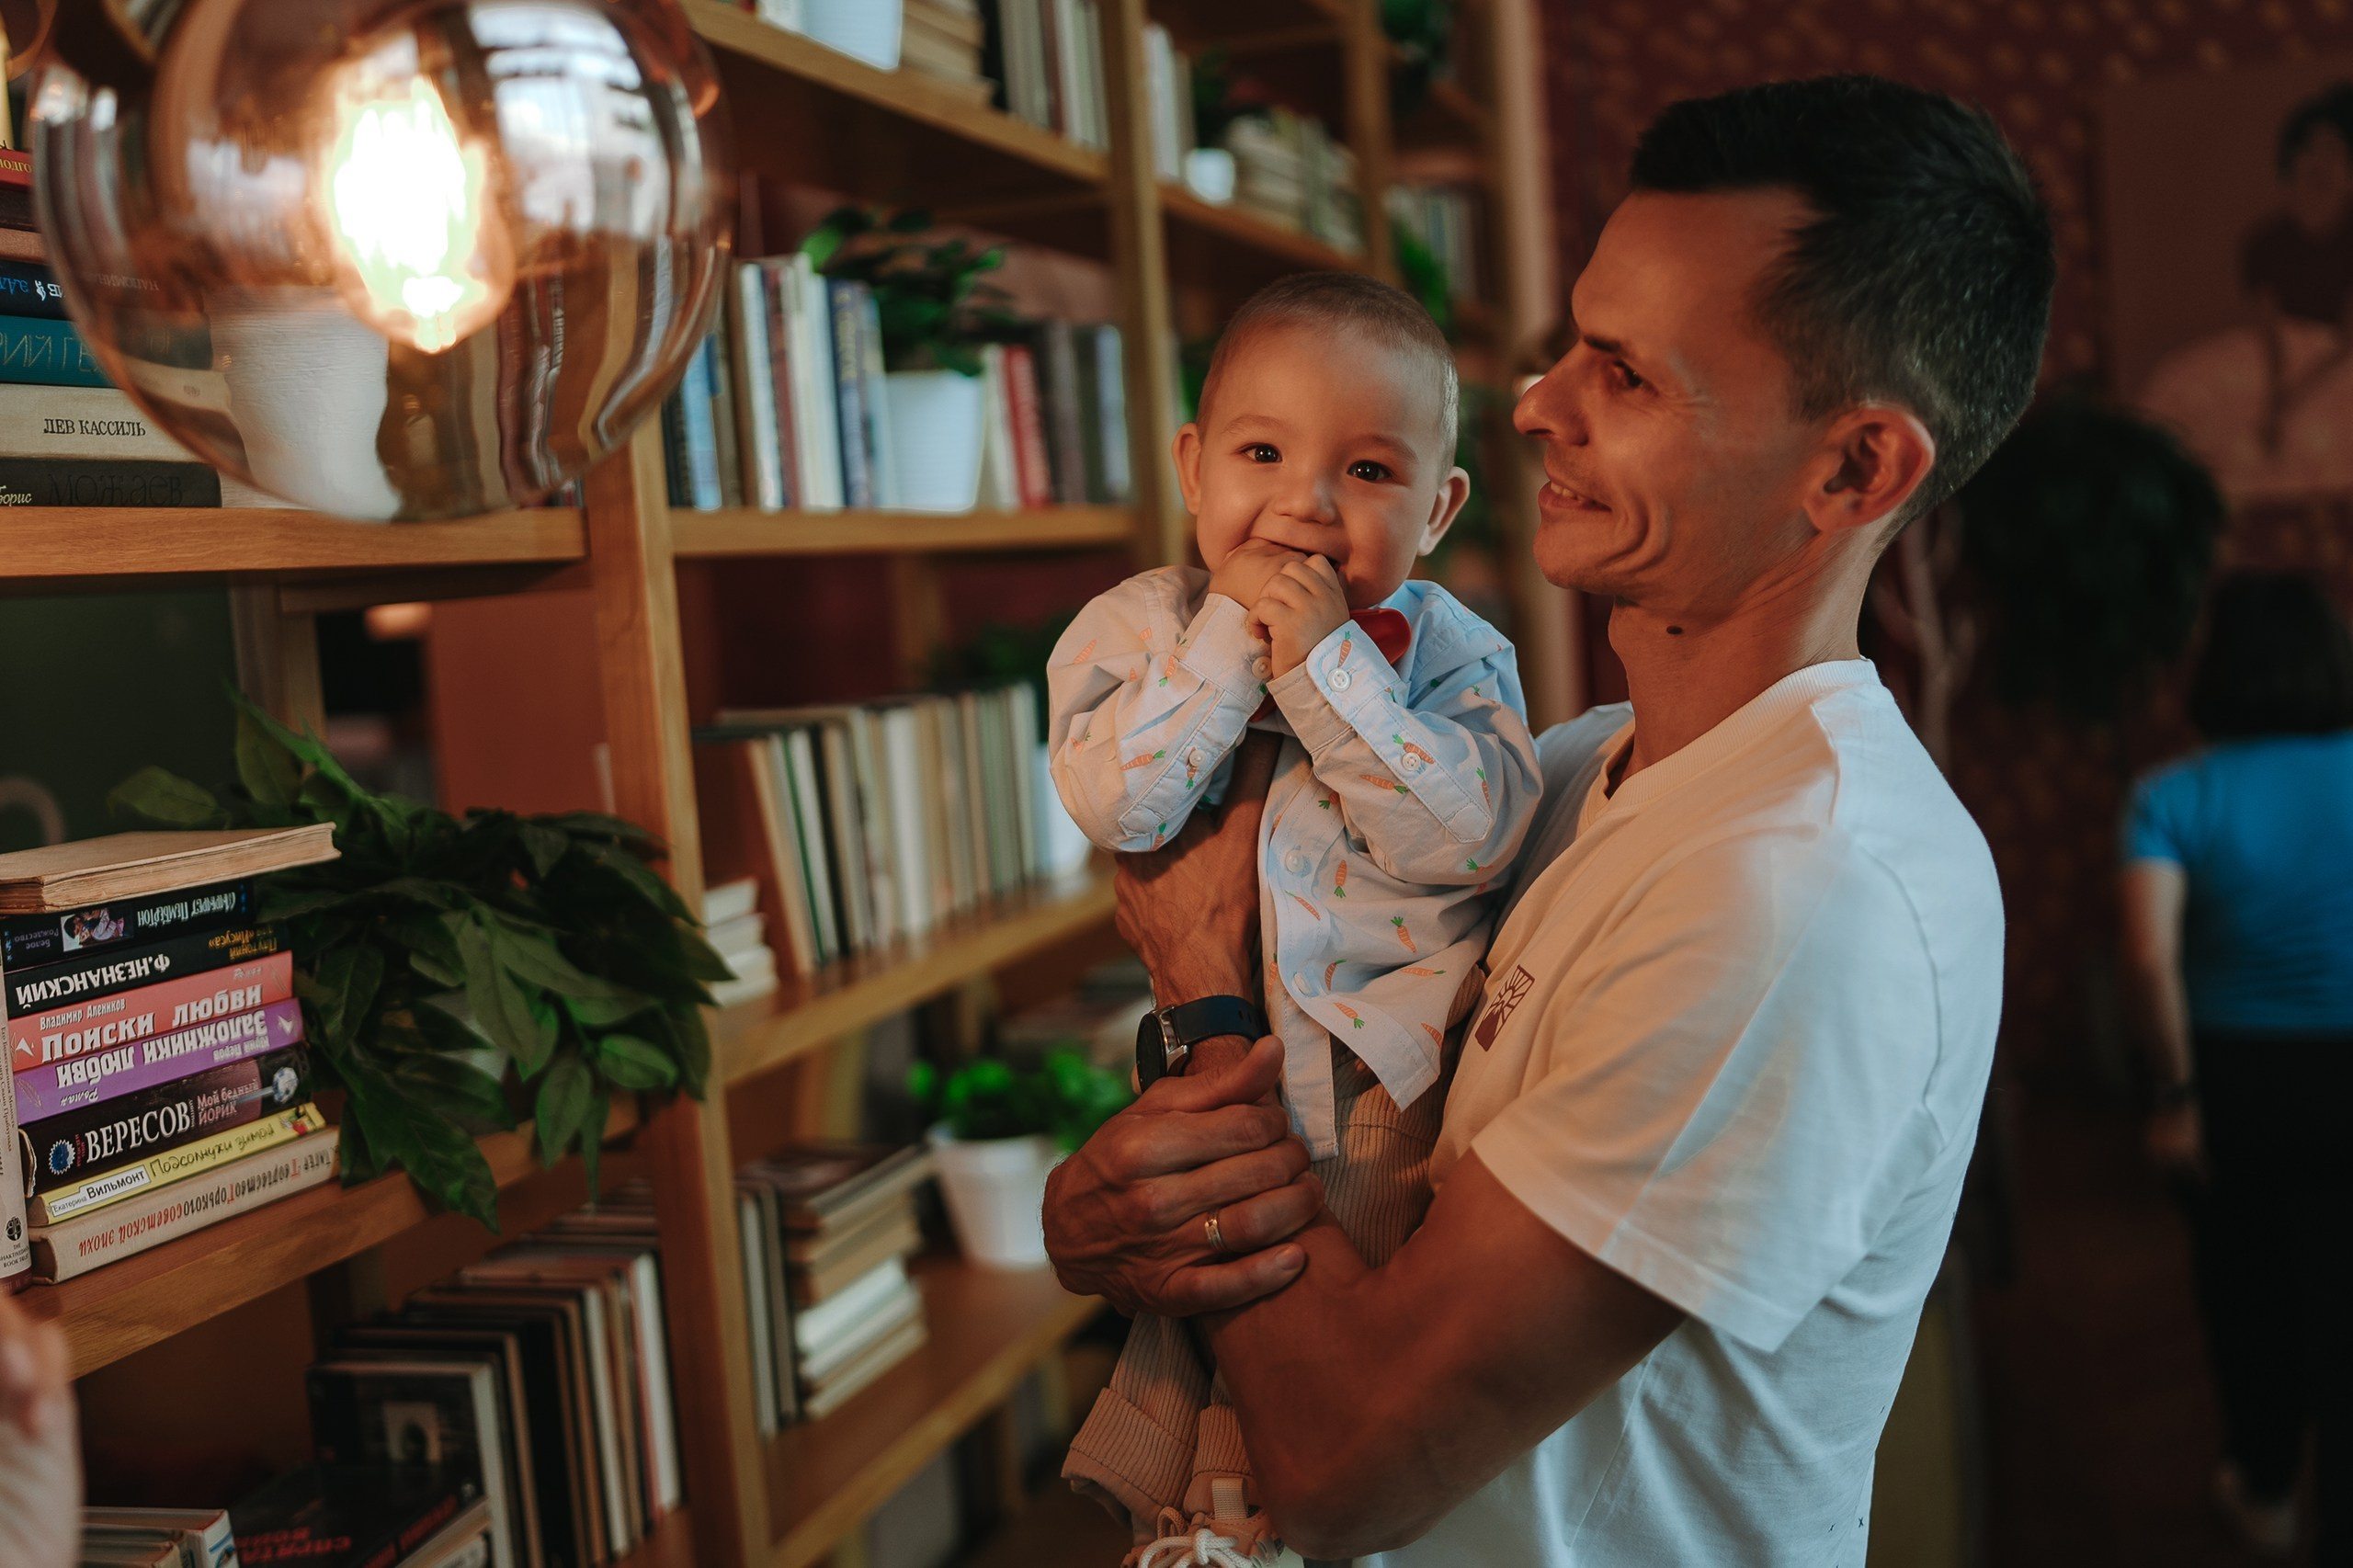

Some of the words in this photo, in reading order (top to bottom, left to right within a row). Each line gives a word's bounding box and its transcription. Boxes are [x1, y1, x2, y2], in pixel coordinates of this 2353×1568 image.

[43, 417, 75, 435] ЛЕВ
[78, 418, 147, 437] КАССИЛЬ
[40, 1008, 84, 1031] Владимир
[86, 997, 127, 1020] Алеников
[41, 1012, 155, 1063] Поиски
[172, 983, 263, 1028] любви
[142, 1009, 267, 1065] Заложники
[55, 1044, 135, 1089] любви
[197, 1090, 221, 1110] Мой
[84, 1100, 192, 1164] ВЕРЕСОВ
[149, 1140, 233, 1178] Подсолнухи
[53, 1196, 87, 1213] Екатерина
[86, 1169, 146, 1200] Вильмонт
